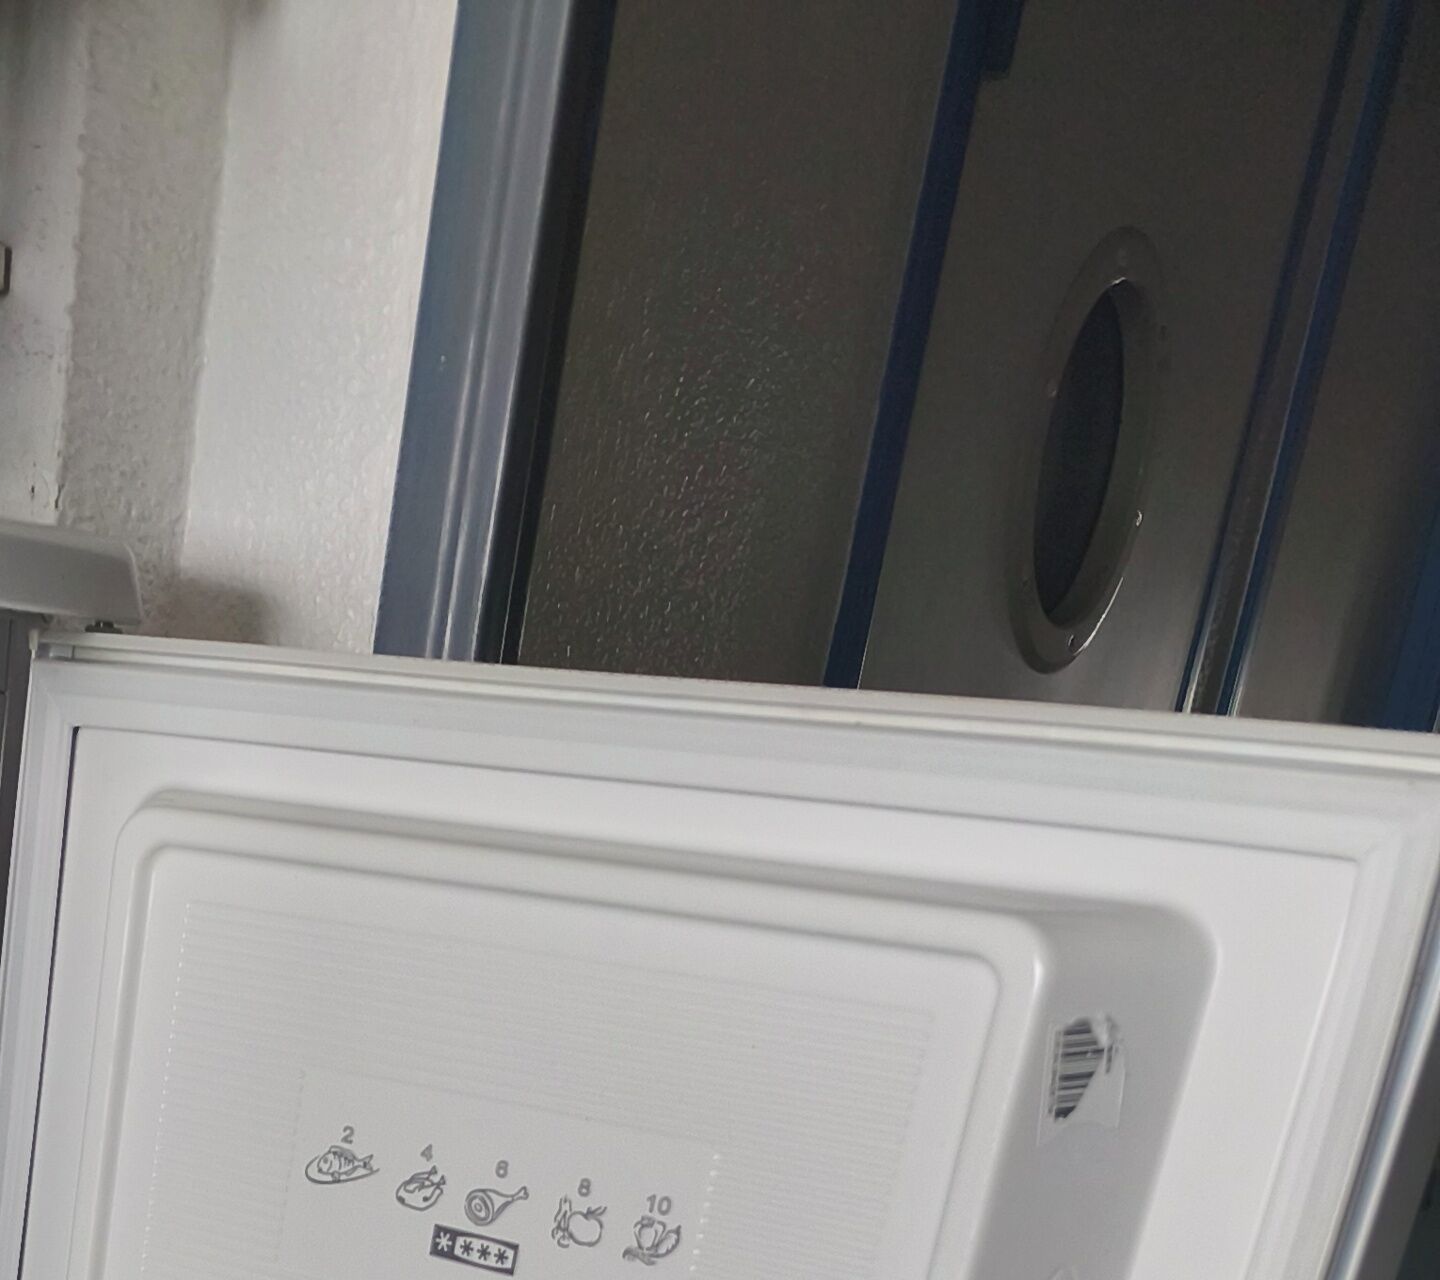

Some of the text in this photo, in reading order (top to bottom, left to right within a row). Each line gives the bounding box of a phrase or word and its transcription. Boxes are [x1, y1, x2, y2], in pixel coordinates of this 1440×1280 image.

[340, 1125, 355, 1145] 2
[420, 1143, 434, 1163] 4
[577, 1177, 592, 1198] 8
[646, 1193, 673, 1217] 10
